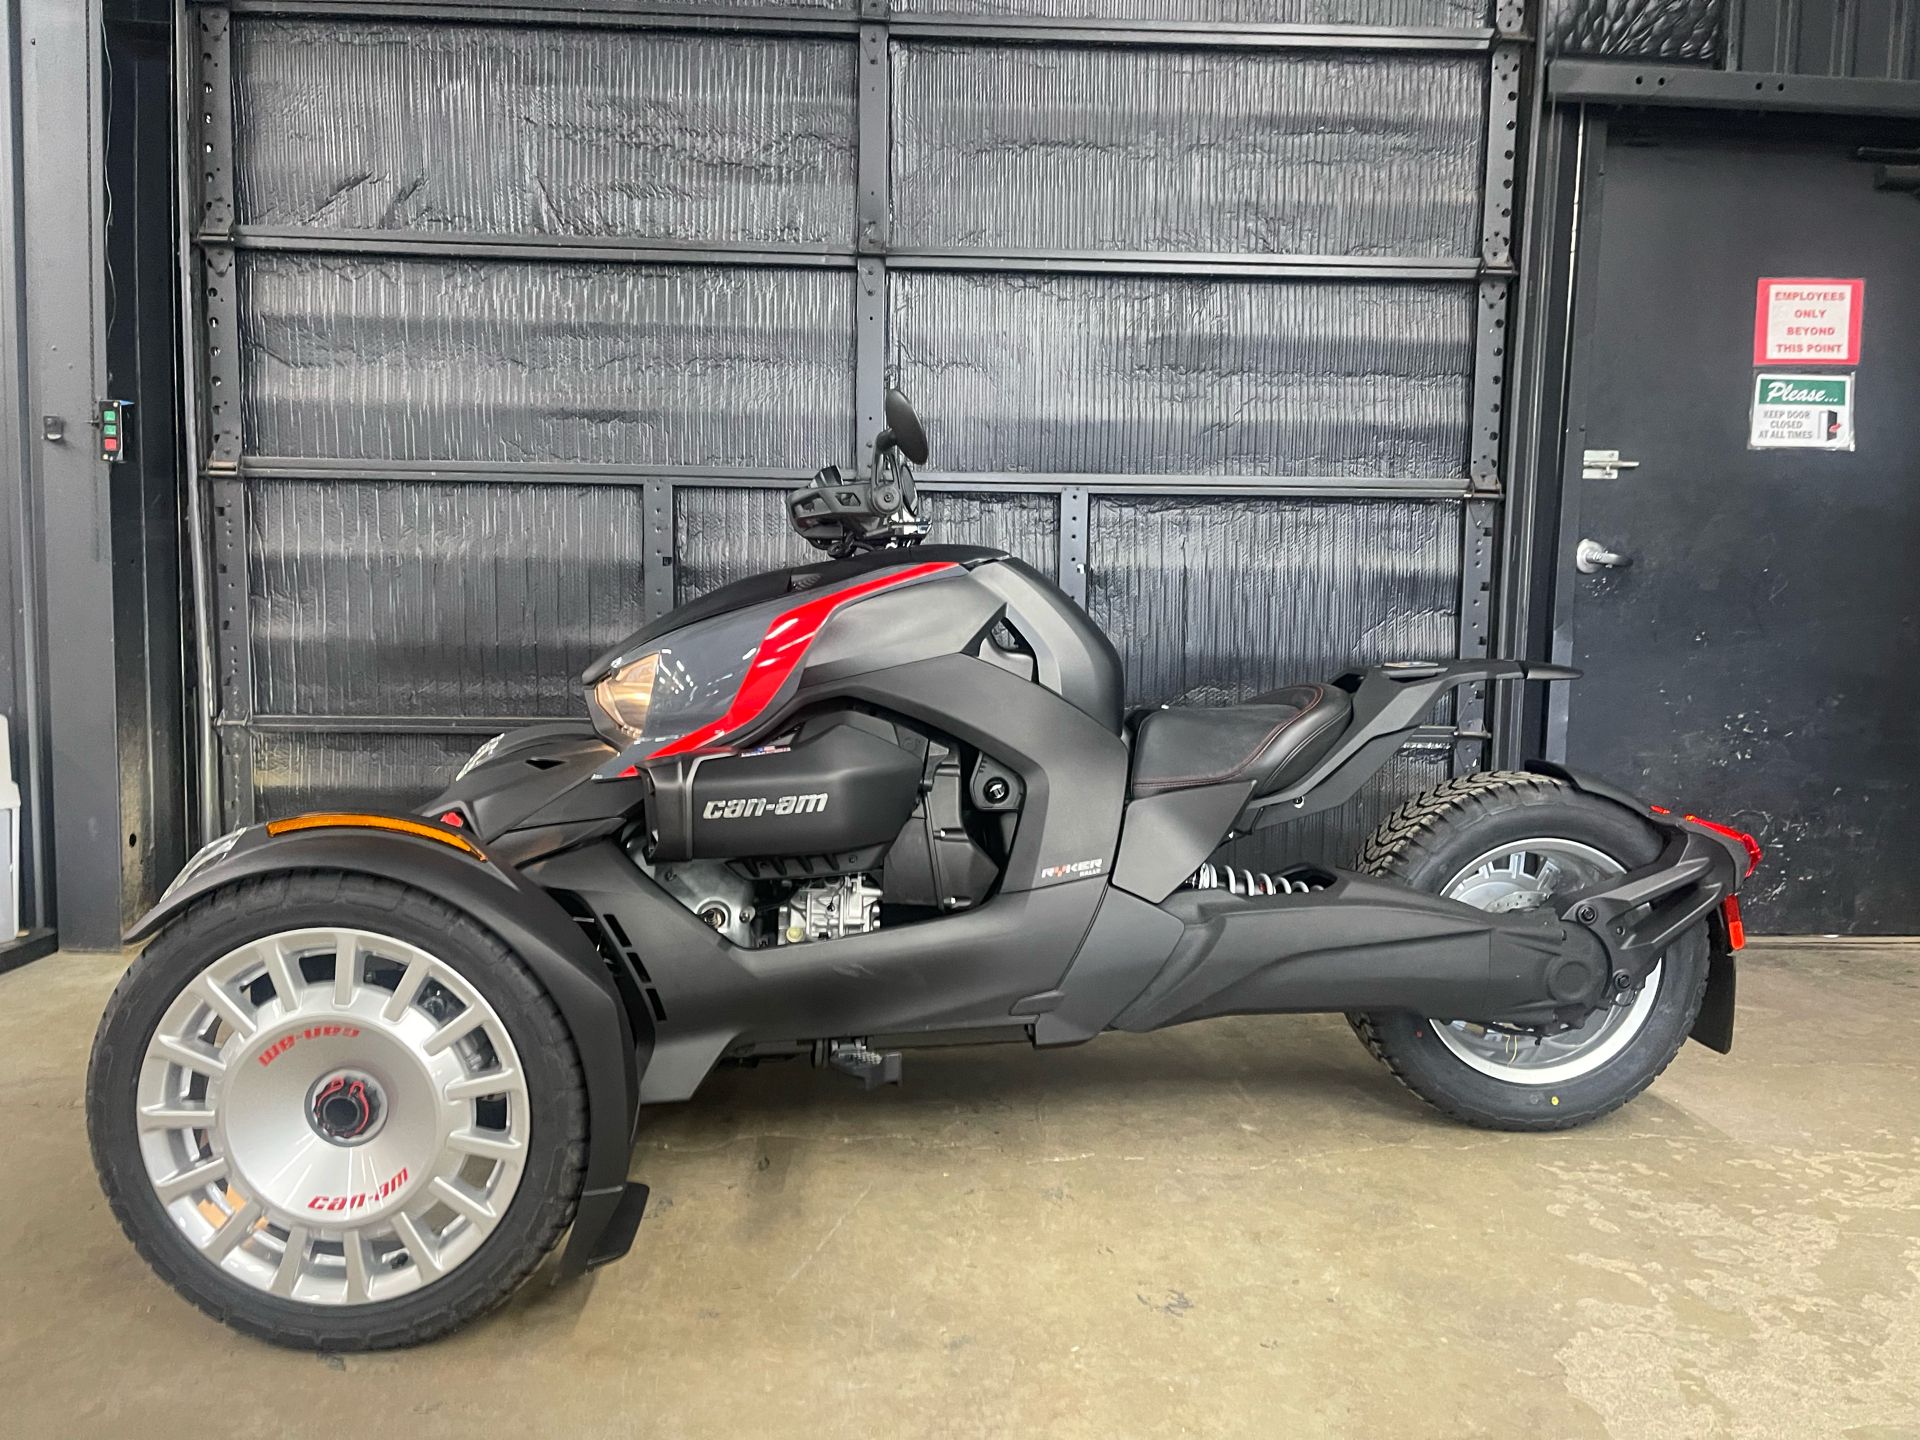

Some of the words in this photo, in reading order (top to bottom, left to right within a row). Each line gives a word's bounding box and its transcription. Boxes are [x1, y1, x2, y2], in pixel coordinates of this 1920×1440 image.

[1775, 292, 1846, 301] EMPLOYEES
[1794, 309, 1826, 318] ONLY
[1786, 327, 1835, 336] BEYOND
[1776, 344, 1803, 353] THIS
[1806, 344, 1843, 353] POINT
[1766, 381, 1839, 403] Please...
[1763, 410, 1786, 419] KEEP
[1787, 410, 1811, 419] DOOR
[1770, 420, 1803, 429] CLOSED
[1758, 430, 1768, 439] AT
[1769, 430, 1785, 439] ALL
[1787, 430, 1813, 439] TIMES
[702, 793, 828, 819] can-am
[1041, 858, 1102, 878] RYKER
[307, 1167, 408, 1211] can-am
